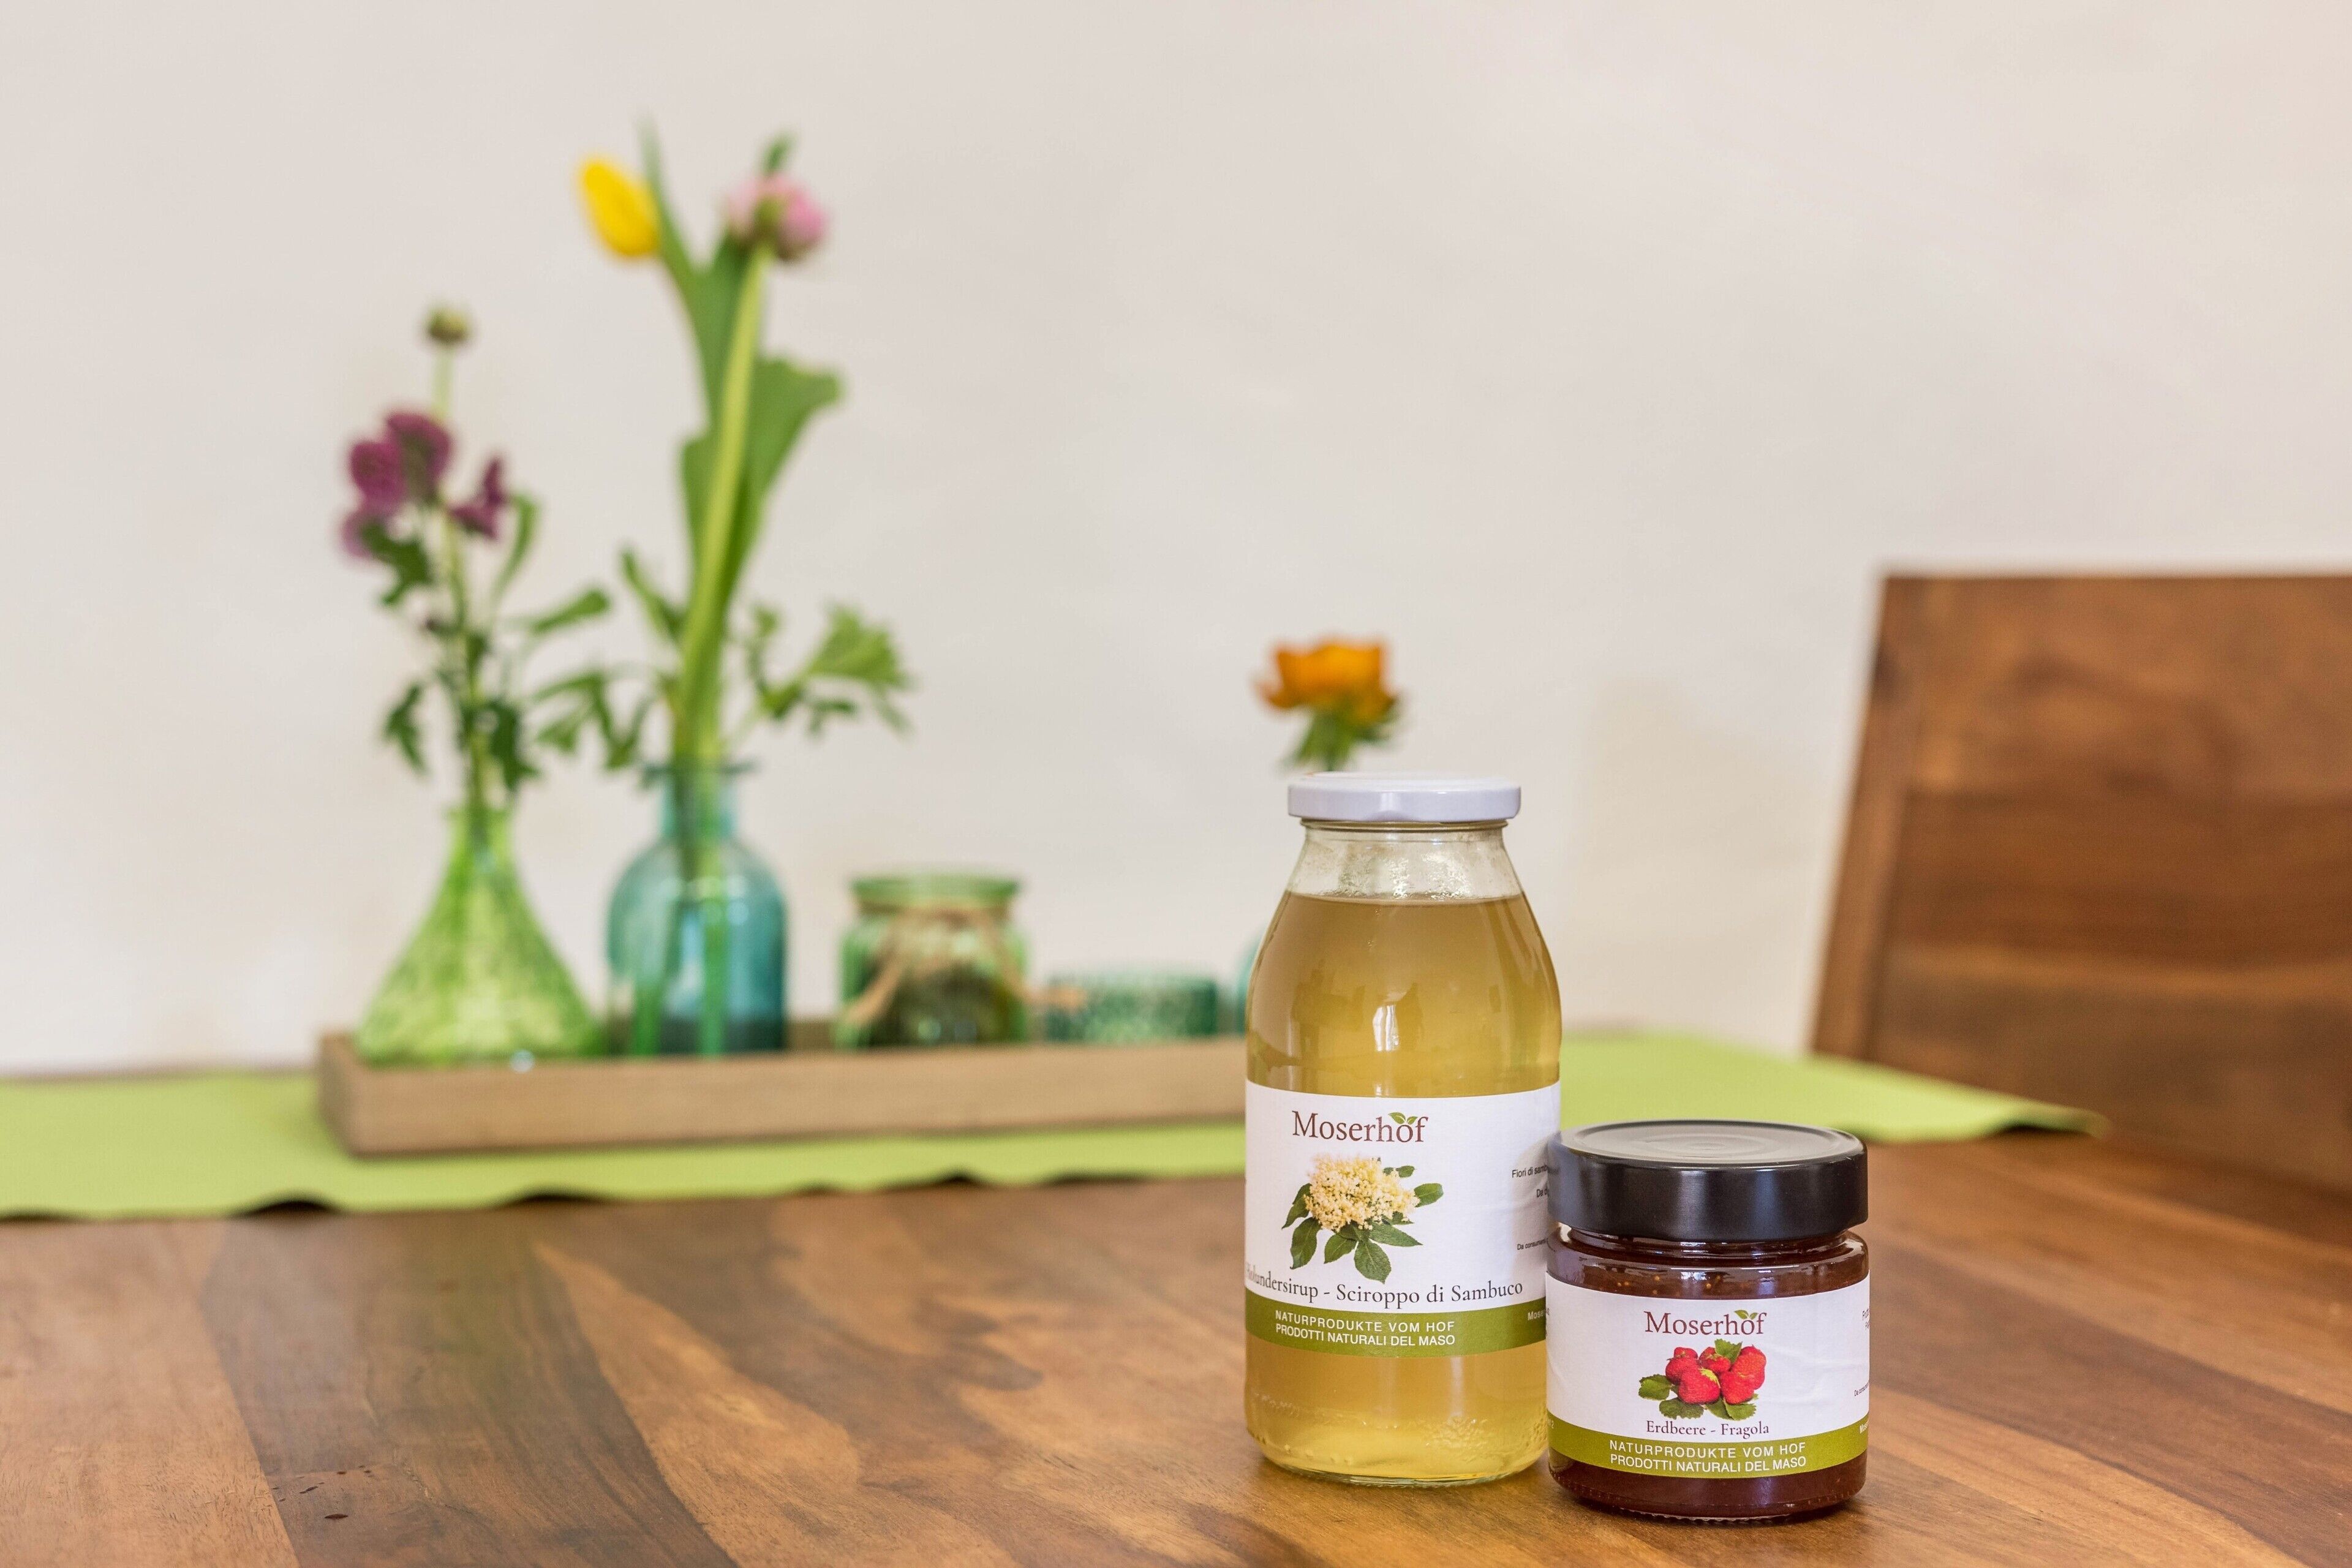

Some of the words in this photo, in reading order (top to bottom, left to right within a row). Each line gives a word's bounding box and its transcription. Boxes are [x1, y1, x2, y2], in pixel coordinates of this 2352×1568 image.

[1292, 1110, 1429, 1143] Moserhof
[1512, 1167, 1526, 1178] Fiori
[1528, 1166, 1533, 1176] di
[1336, 1284, 1420, 1310] Sciroppo
[1427, 1284, 1444, 1302] di
[1451, 1280, 1523, 1302] Sambuco
[1275, 1310, 1382, 1332] NATURPRODUKTE
[1389, 1322, 1420, 1333] VOM
[1426, 1321, 1455, 1333] HOF
[1643, 1311, 1767, 1335] Moserhof
[1275, 1324, 1324, 1341] PRODOTTI
[1327, 1332, 1387, 1346] NATURALI
[1390, 1336, 1415, 1346] DEL
[1419, 1335, 1455, 1346] MASO
[1646, 1420, 1706, 1436] Erdbeere
[1721, 1421, 1770, 1439] Fragola
[1609, 1439, 1736, 1458] NATURPRODUKTE
[1743, 1446, 1774, 1458] VOM
[1779, 1442, 1806, 1456] HOF
[1610, 1453, 1672, 1471] PRODOTTI
[1676, 1461, 1741, 1473] NATURALI
[1745, 1461, 1770, 1472] DEL
[1772, 1456, 1806, 1471] MASO
